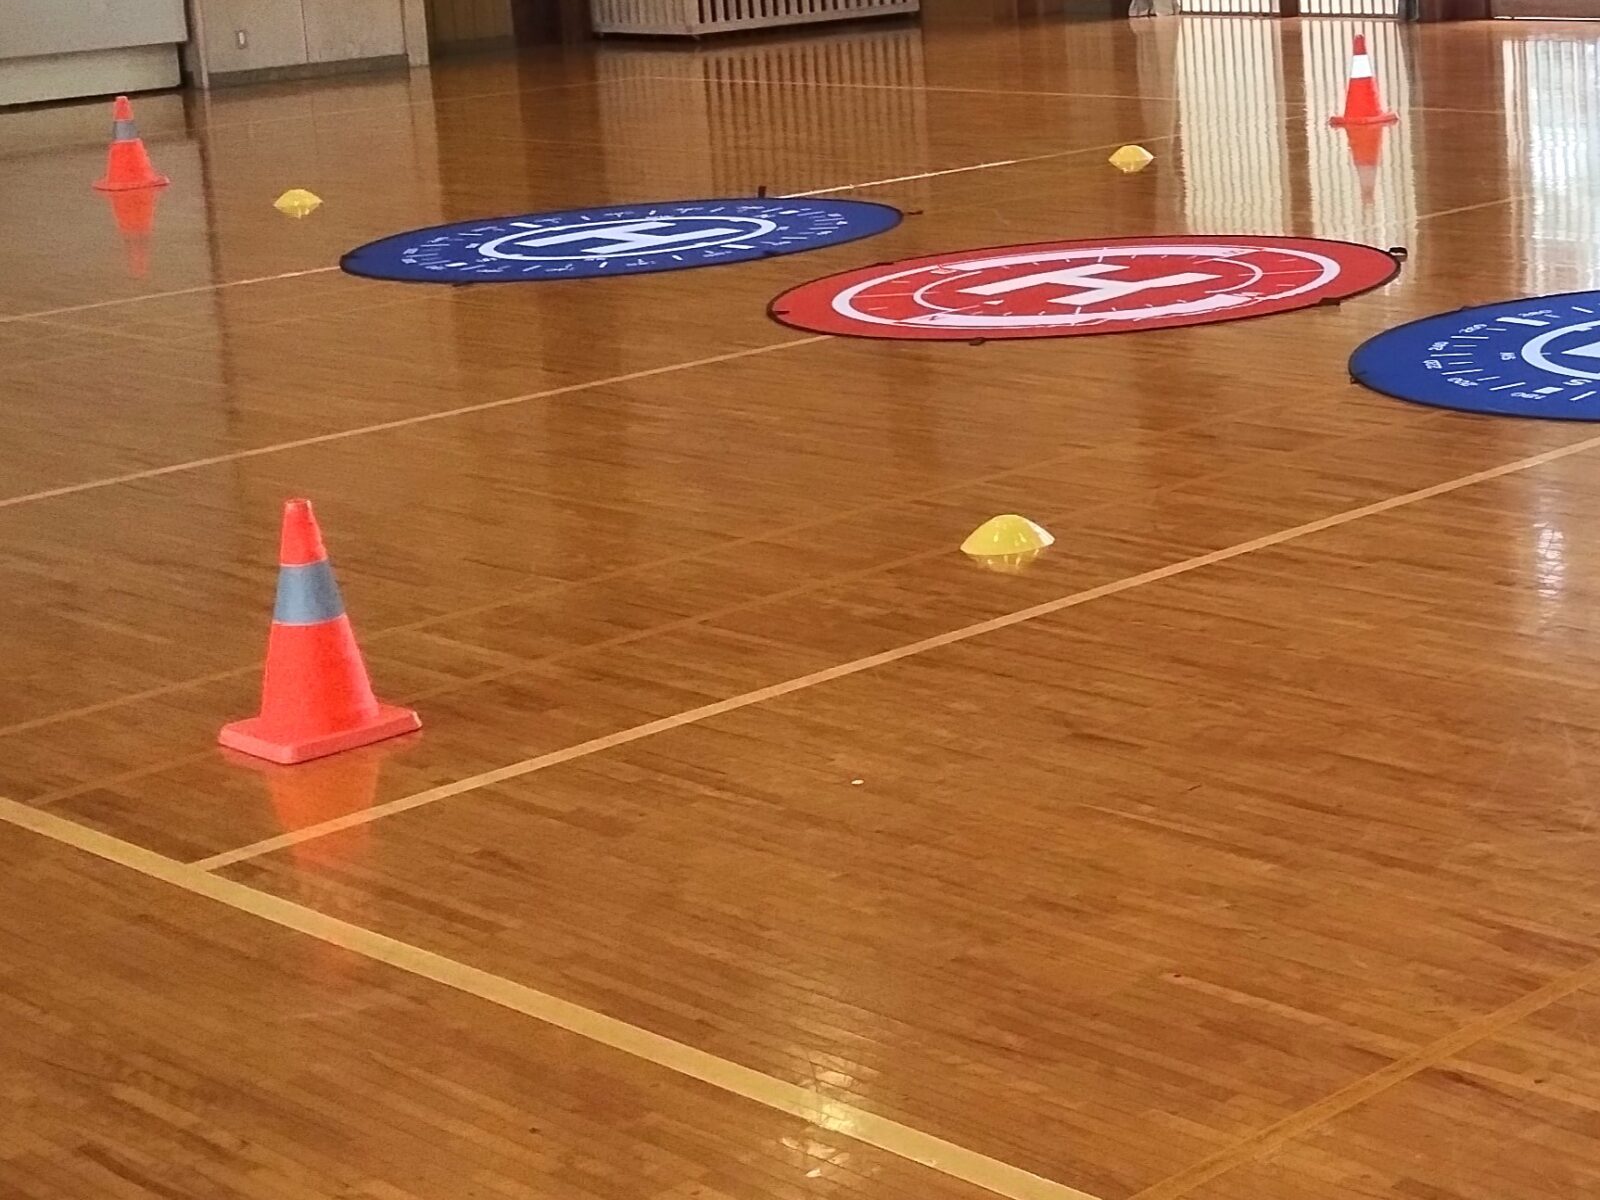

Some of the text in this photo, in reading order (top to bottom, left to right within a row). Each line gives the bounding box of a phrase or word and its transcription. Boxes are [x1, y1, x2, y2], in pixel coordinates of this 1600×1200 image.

[513, 221, 743, 255] H
[956, 263, 1224, 305] H
[1562, 378, 1592, 387] S
